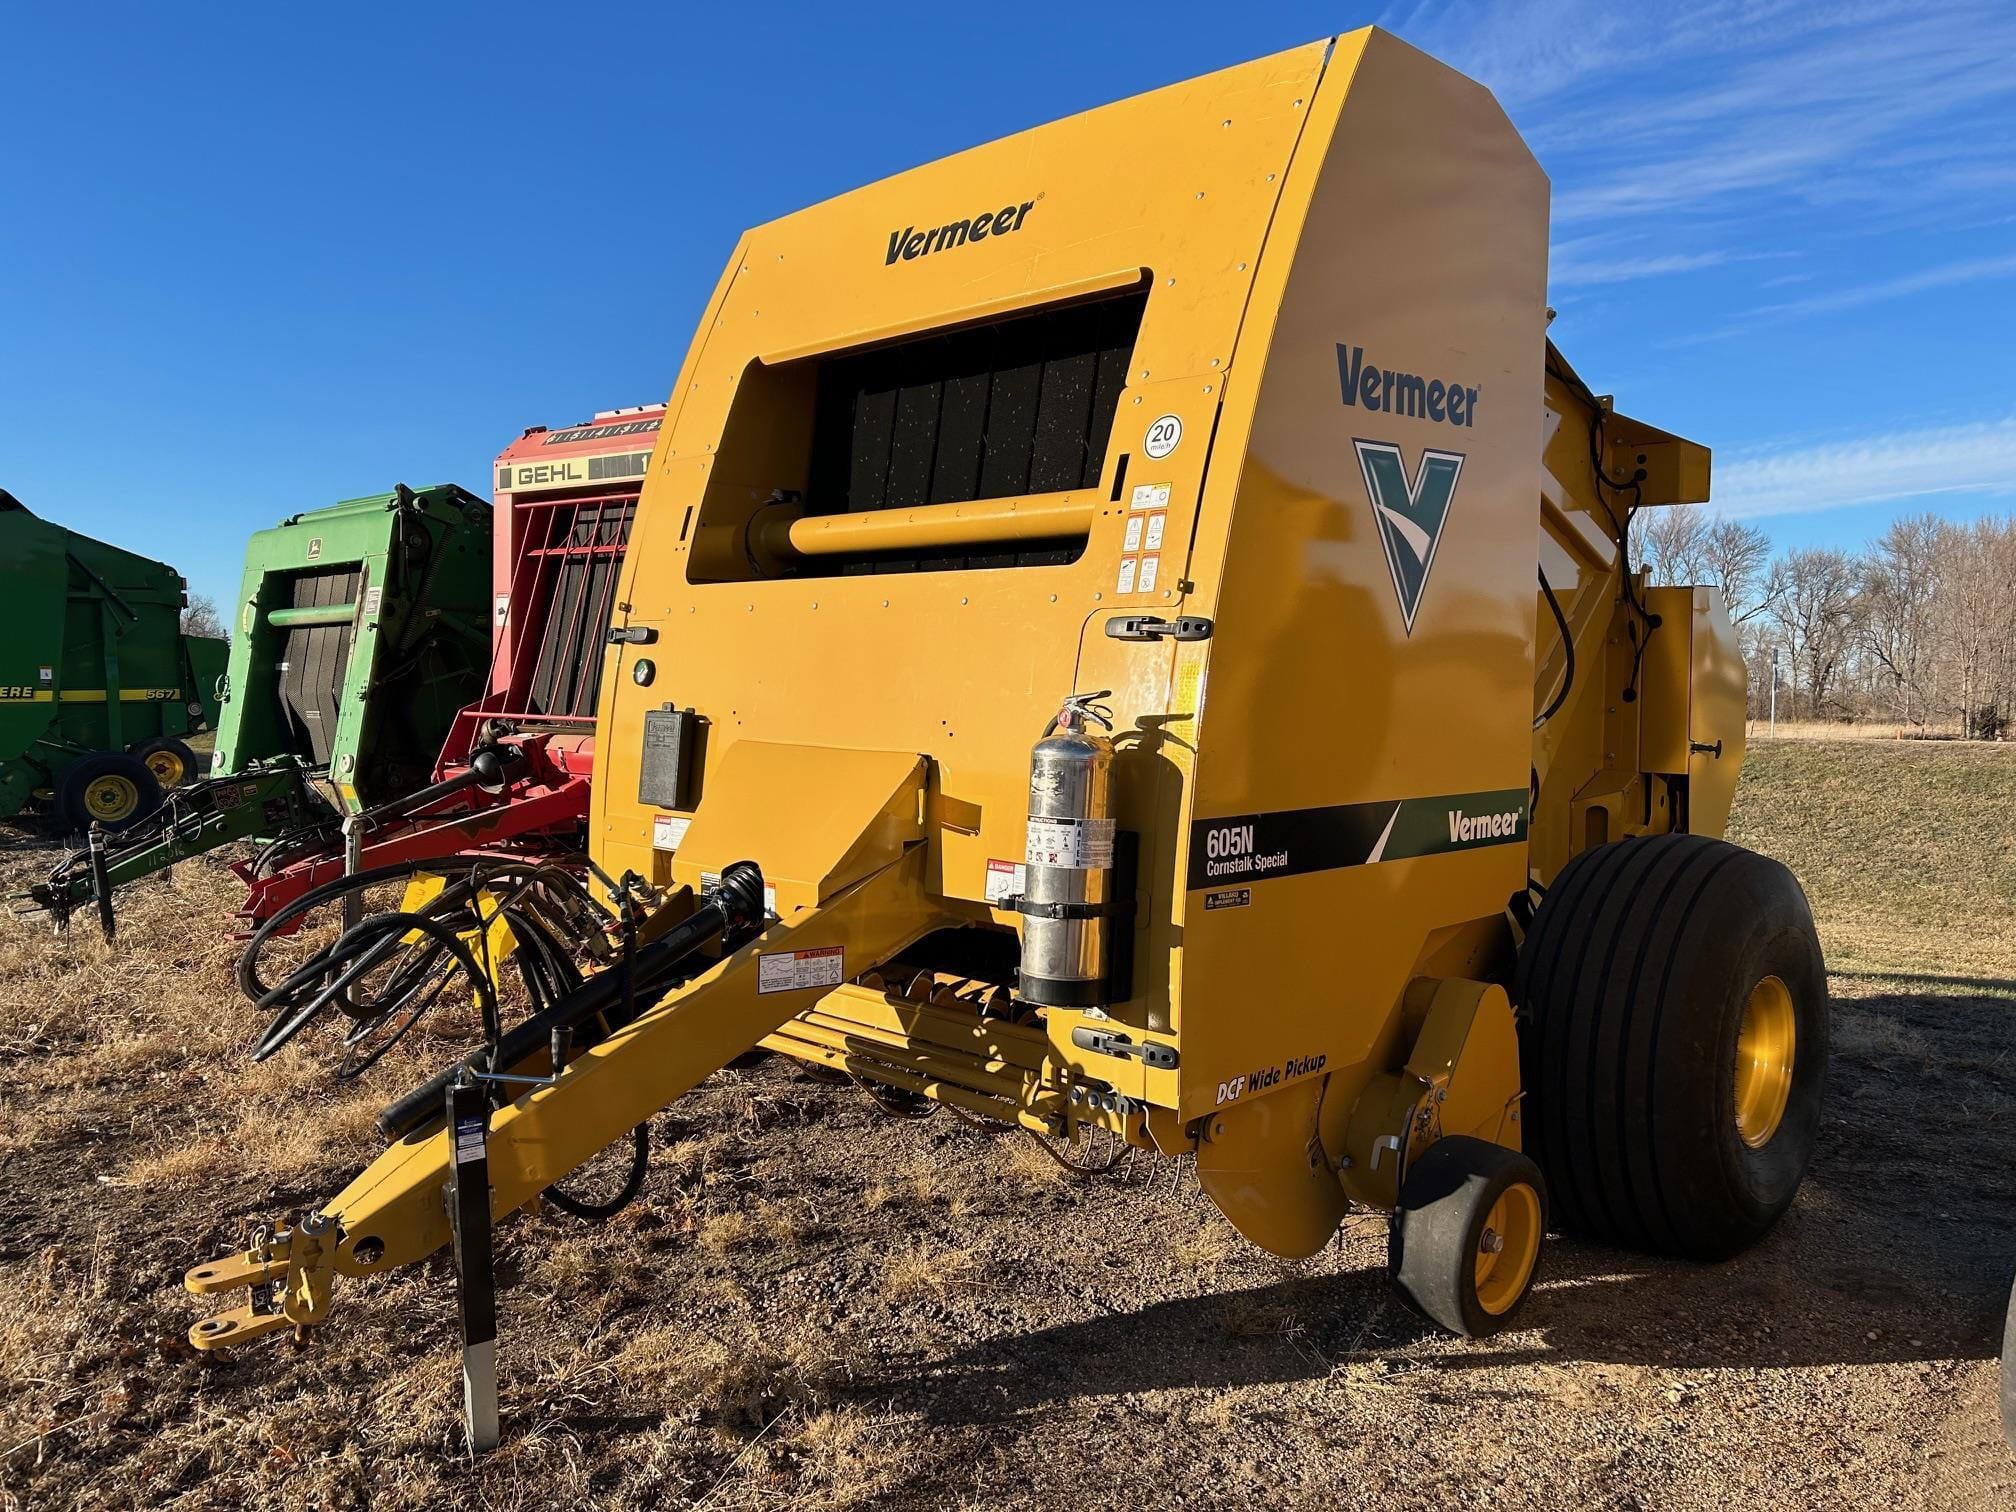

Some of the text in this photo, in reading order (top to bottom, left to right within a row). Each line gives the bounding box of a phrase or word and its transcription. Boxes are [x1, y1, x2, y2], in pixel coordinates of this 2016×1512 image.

[885, 200, 1035, 266] Vermeer
[1336, 342, 1478, 428] Vermeer
[1152, 423, 1174, 442] 20
[518, 463, 582, 485] GEHL
[146, 689, 174, 699] 567
[1448, 809, 1519, 843] Vermeer
[1206, 824, 1254, 859] 605N
[1206, 850, 1288, 877] Cornstalk Special
[809, 947, 841, 957] WARNING
[1216, 1054, 1327, 1105] DCF Wide Pickup
